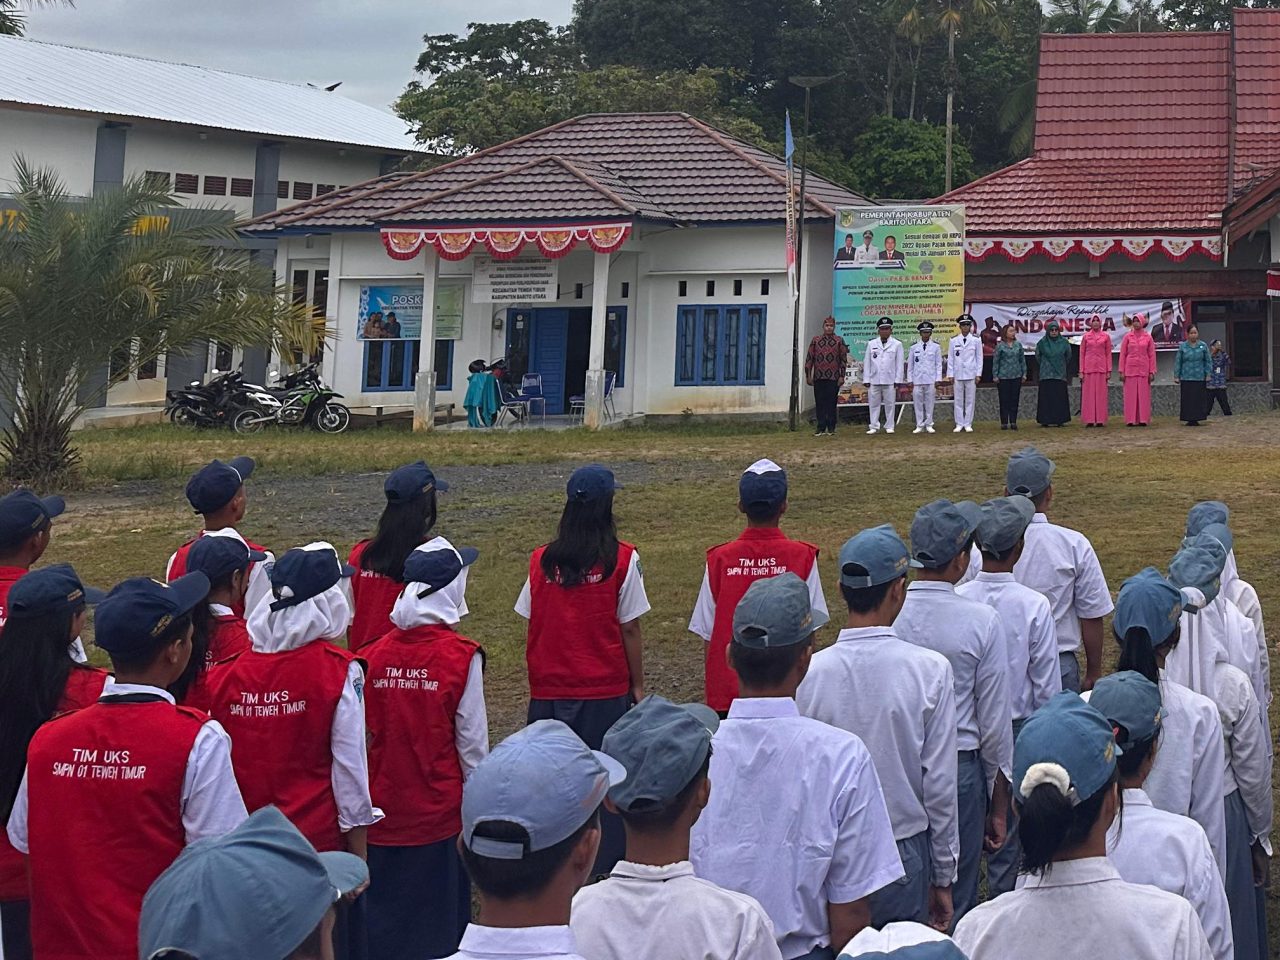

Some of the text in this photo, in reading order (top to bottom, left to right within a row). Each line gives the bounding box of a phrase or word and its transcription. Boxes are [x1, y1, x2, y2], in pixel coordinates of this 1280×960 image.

[861, 210, 951, 219] PEMERINTAH KABUPATEN
[392, 295, 423, 305] POSK
[1017, 305, 1109, 320] Dirgahayu Republik
[1008, 317, 1116, 333] INDNESA
[739, 558, 776, 567] TIM UKS
[727, 566, 786, 576] SMPN 01 TEWEH TIMUR
[386, 667, 428, 678] TIM UKS
[373, 679, 438, 691] SMPN 01 TEWEH TIMUR
[241, 690, 289, 704] TIM UKS
[230, 700, 306, 717] SMPN 01 TEWEH TIMUR
[73, 748, 130, 763] TIM UKS
[52, 762, 146, 779] SMPN 01 TEWEH TIMUR
